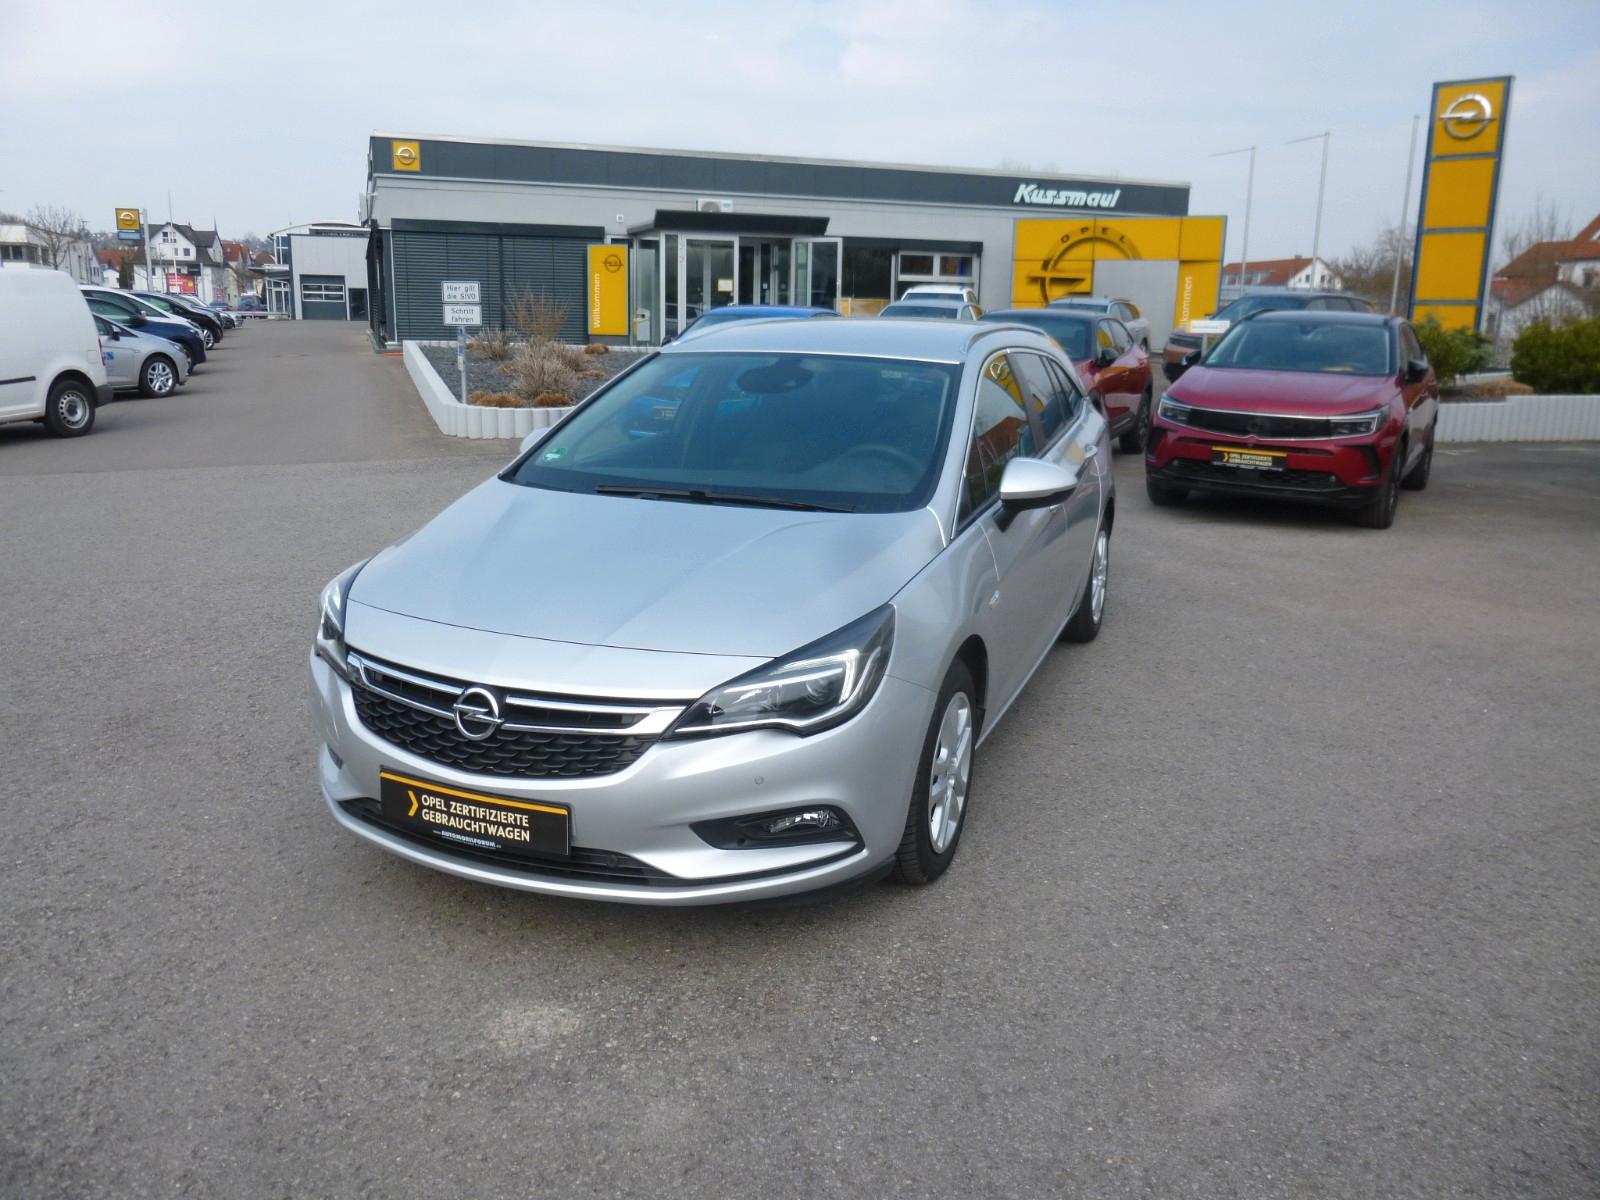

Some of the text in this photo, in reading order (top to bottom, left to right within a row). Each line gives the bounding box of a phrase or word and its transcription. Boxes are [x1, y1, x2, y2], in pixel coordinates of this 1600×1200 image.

[1013, 183, 1121, 208] Kussmaul
[1060, 226, 1126, 244] OPEL
[446, 284, 475, 293] Hier gilt
[592, 272, 601, 329] Willkommen
[421, 794, 529, 827] OPEL ZERTIFIZIERTE
[421, 809, 530, 842] GEBRAUCHTWAGEN
